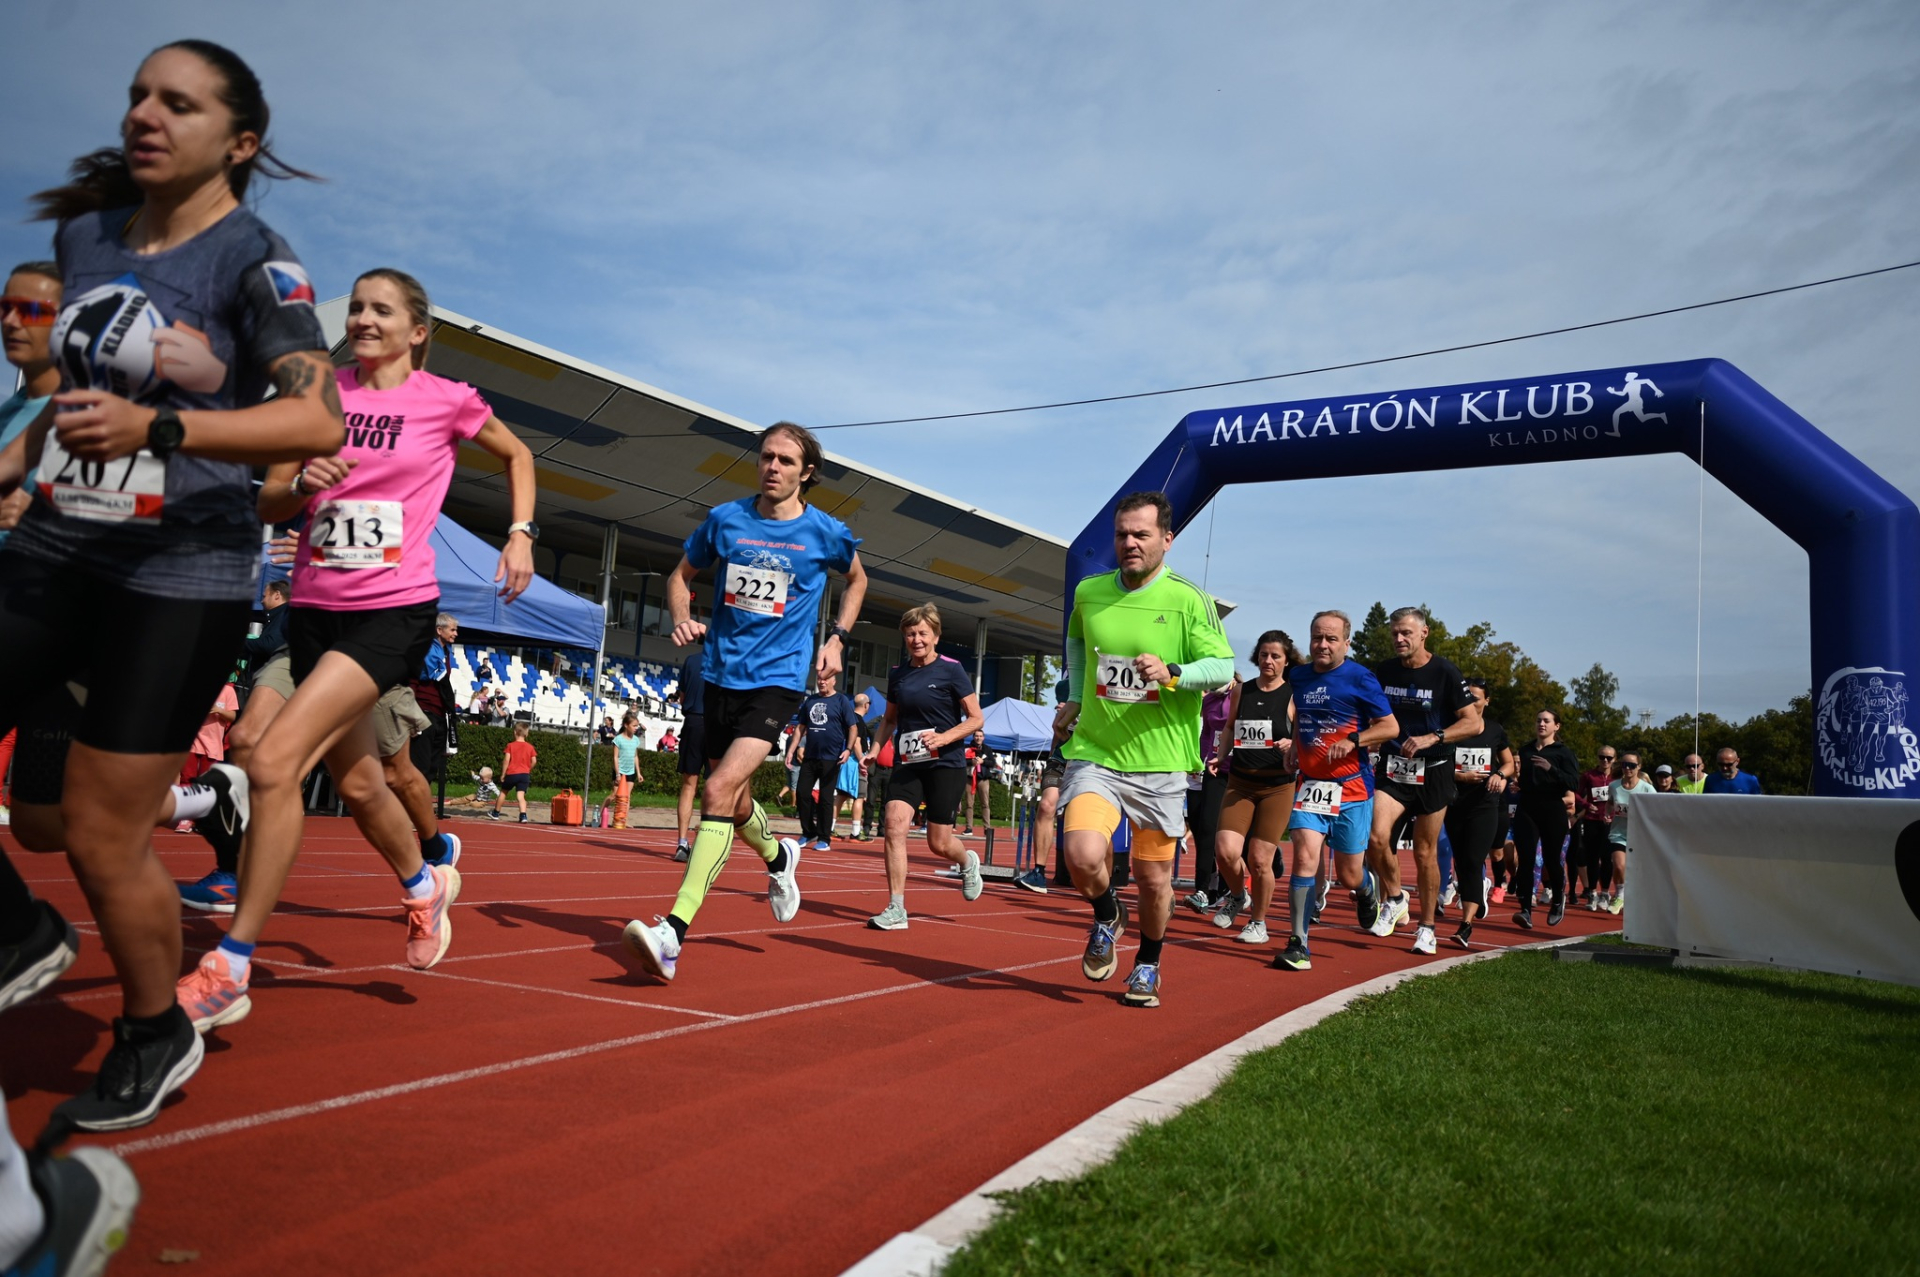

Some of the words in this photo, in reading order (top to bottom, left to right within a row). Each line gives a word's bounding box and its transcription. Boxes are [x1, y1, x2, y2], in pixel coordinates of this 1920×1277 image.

[101, 295, 148, 358] KLADNO
[1210, 394, 1441, 447] MARATÓN
[1458, 381, 1595, 425] KLUB
[342, 427, 401, 450] IVOT
[1488, 425, 1598, 448] KLADNO
[322, 516, 383, 547] 213
[735, 576, 776, 601] 222
[1240, 726, 1266, 741] 206
[904, 738, 930, 754] 22
[1393, 761, 1418, 776] 234
[1461, 753, 1485, 766] 216
[1302, 787, 1333, 805] 204
